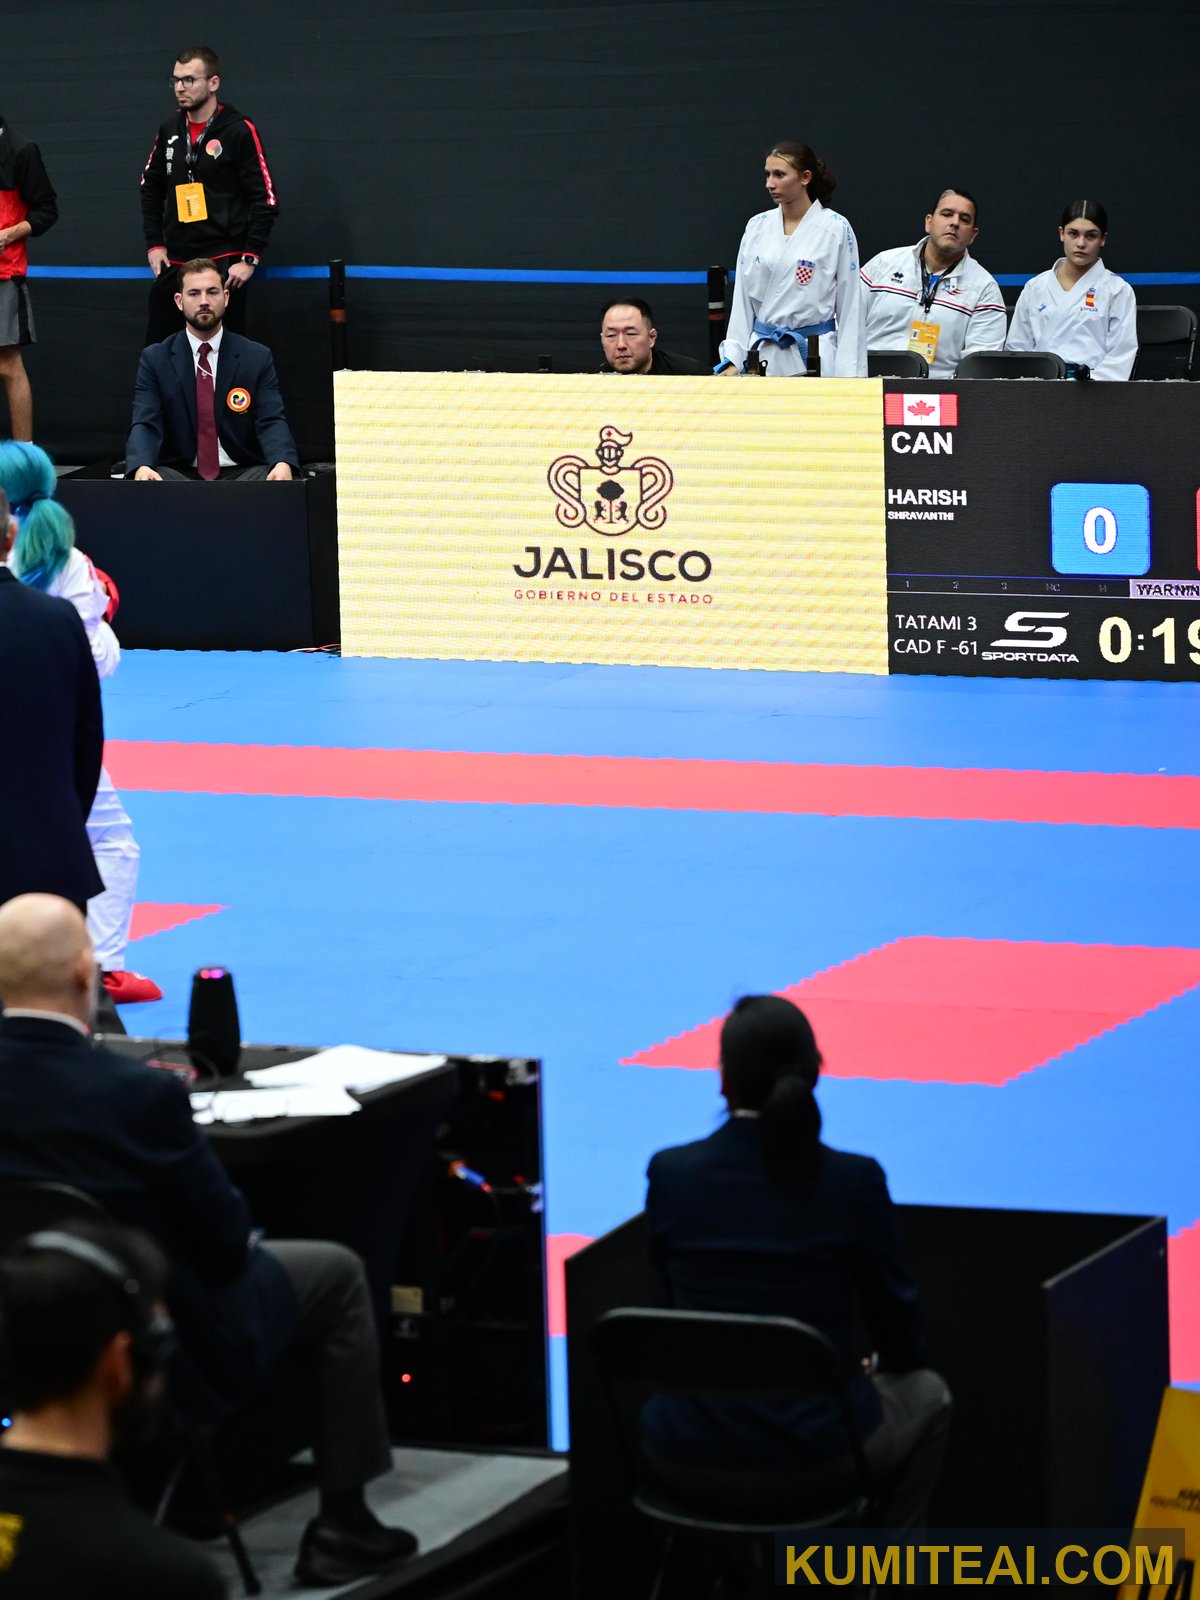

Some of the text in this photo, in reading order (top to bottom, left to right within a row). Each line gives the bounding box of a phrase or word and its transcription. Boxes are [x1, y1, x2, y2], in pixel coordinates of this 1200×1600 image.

[891, 431, 953, 454] CAN
[888, 488, 967, 506] HARISH
[887, 511, 954, 521] SHRAVANTHI
[1083, 507, 1117, 554] 0
[513, 546, 712, 582] JALISCO
[514, 589, 713, 604] GOBIERNO DEL ESTADO
[895, 614, 977, 631] TATAMI 3
[894, 639, 977, 655] CAD F -61
[982, 651, 1079, 663] SPORTDATA
